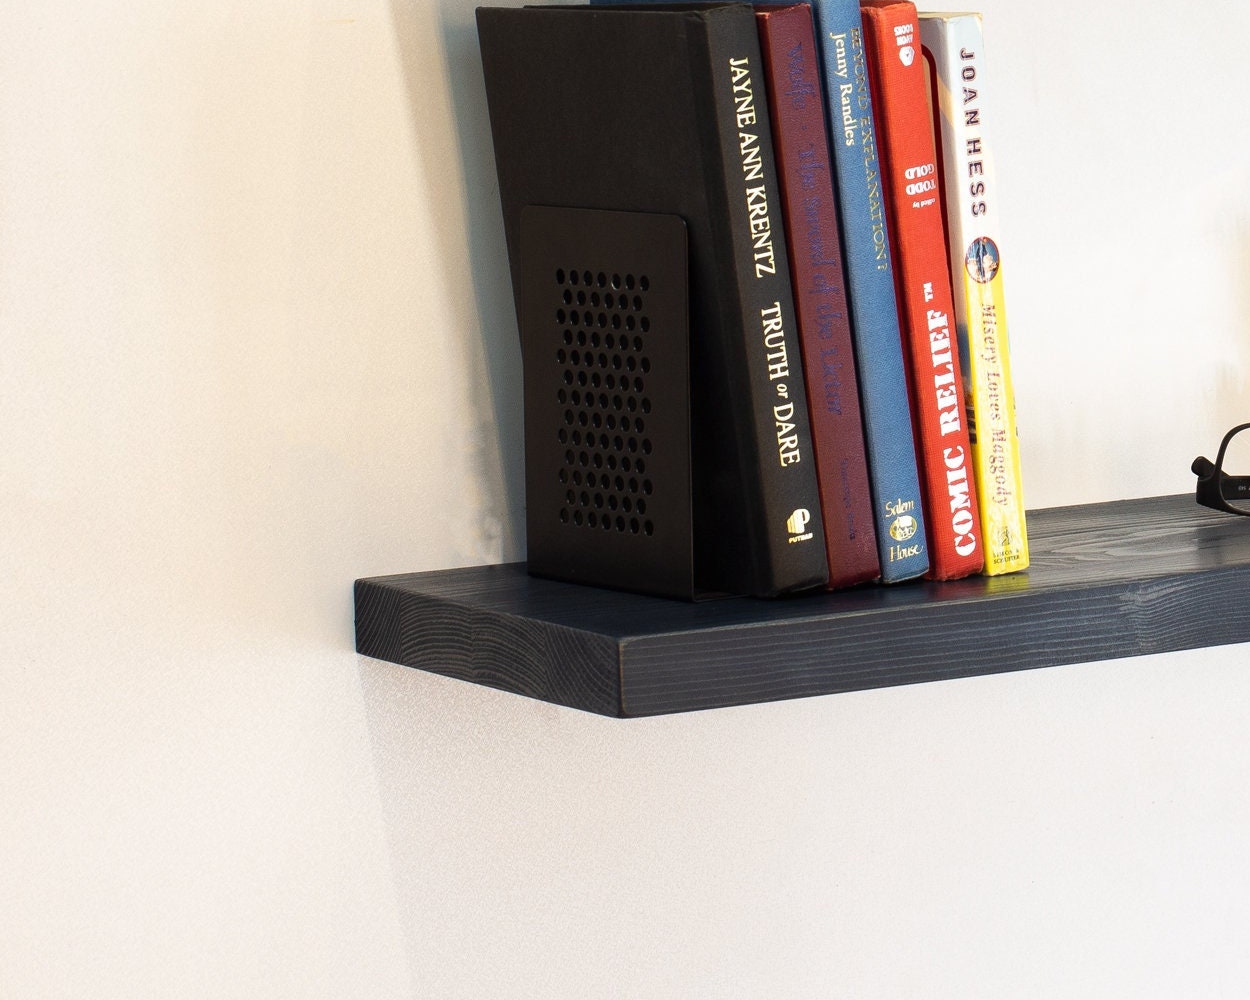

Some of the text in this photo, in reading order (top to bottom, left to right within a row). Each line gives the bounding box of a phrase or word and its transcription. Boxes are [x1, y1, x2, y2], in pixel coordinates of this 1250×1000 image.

[829, 31, 858, 147] Jenny Randles
[850, 26, 868, 111] BEYOND
[728, 56, 776, 279] JAYNE ANN KRENTZ
[904, 163, 935, 180] GOLD
[905, 178, 937, 196] TODD
[959, 47, 987, 218] JOAN HESS
[760, 301, 802, 468] TRUTH or DARE
[926, 309, 961, 438] RELIEF
[980, 303, 1013, 507] Misery Loves Maggody
[884, 497, 915, 519] Salem
[888, 544, 924, 563] House
[943, 444, 977, 558] COMIC
